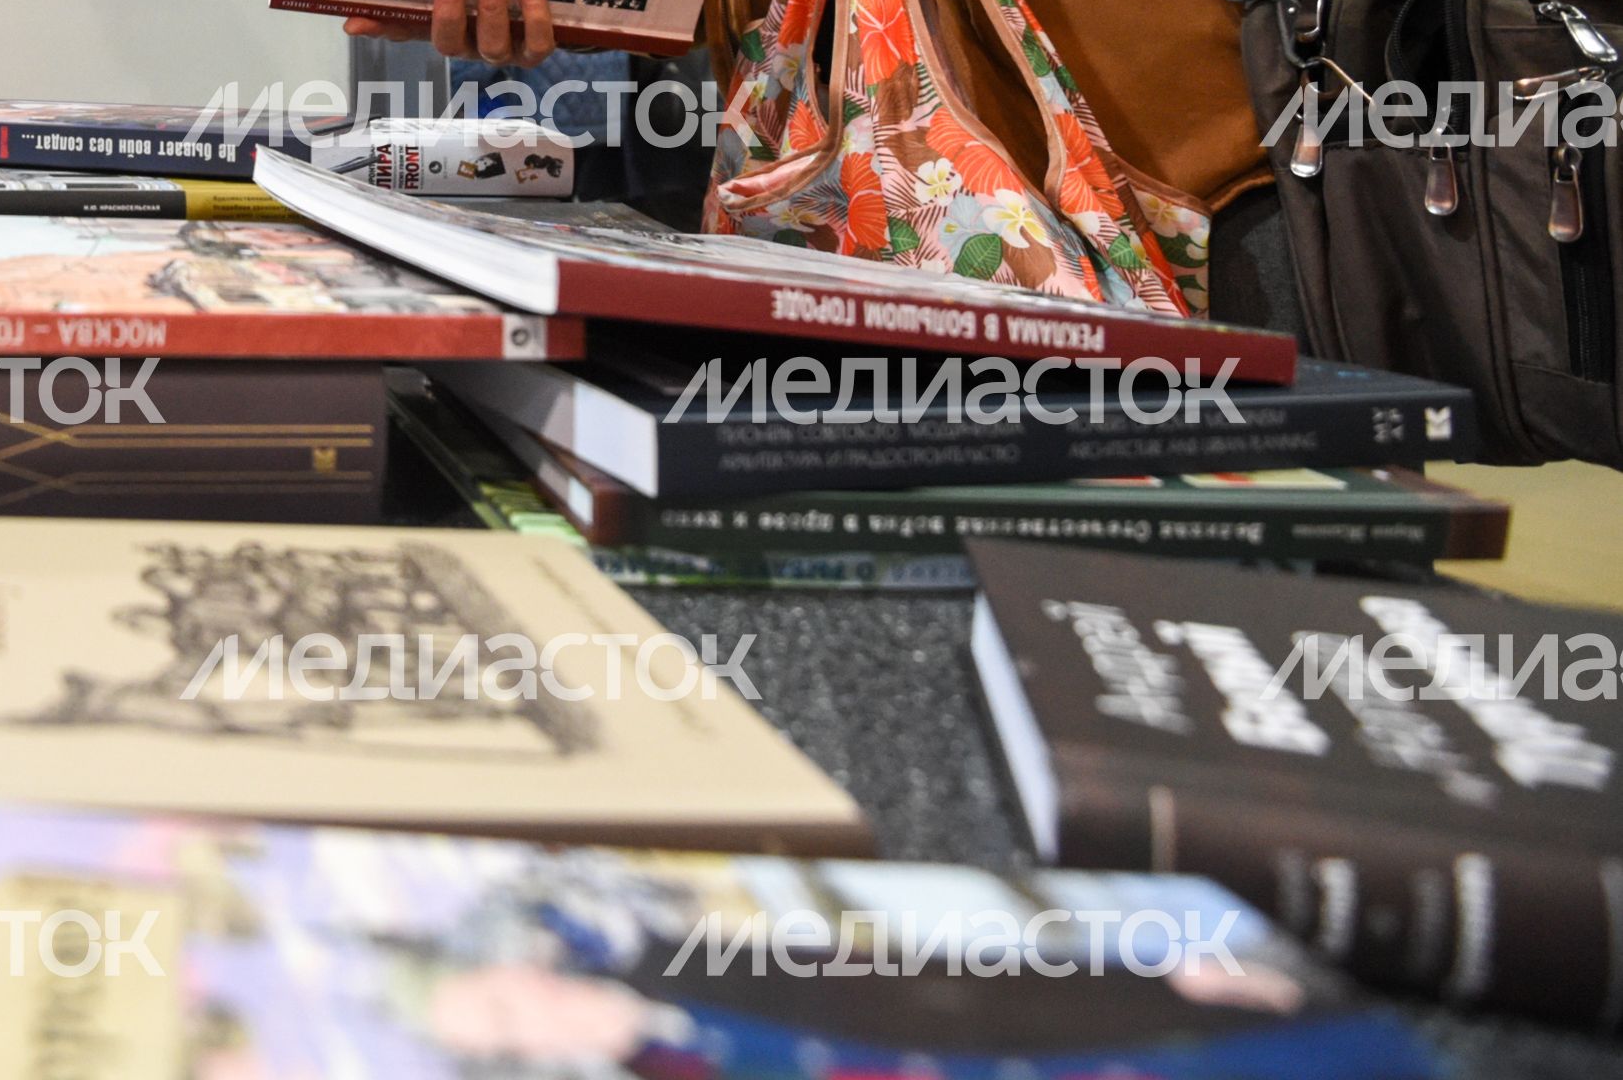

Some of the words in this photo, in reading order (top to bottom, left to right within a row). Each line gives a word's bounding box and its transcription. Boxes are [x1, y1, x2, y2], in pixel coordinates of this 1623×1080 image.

[21, 133, 84, 154] солдат...
[88, 136, 114, 157] без
[118, 138, 152, 157] войн
[157, 139, 213, 162] бывает
[218, 144, 237, 163] Не
[376, 143, 392, 190] ЛИРА
[405, 143, 420, 190] FRONT
[770, 286, 857, 327] ГОРОДЕ
[862, 300, 977, 340] БОЛЬШОМ
[57, 319, 167, 347] МОСКВА
[983, 313, 1000, 342] В
[1006, 315, 1106, 353] РЕКЛАМА
[867, 510, 945, 536] война
[954, 515, 1152, 542] Отечественная
[1158, 520, 1264, 546] Великая
